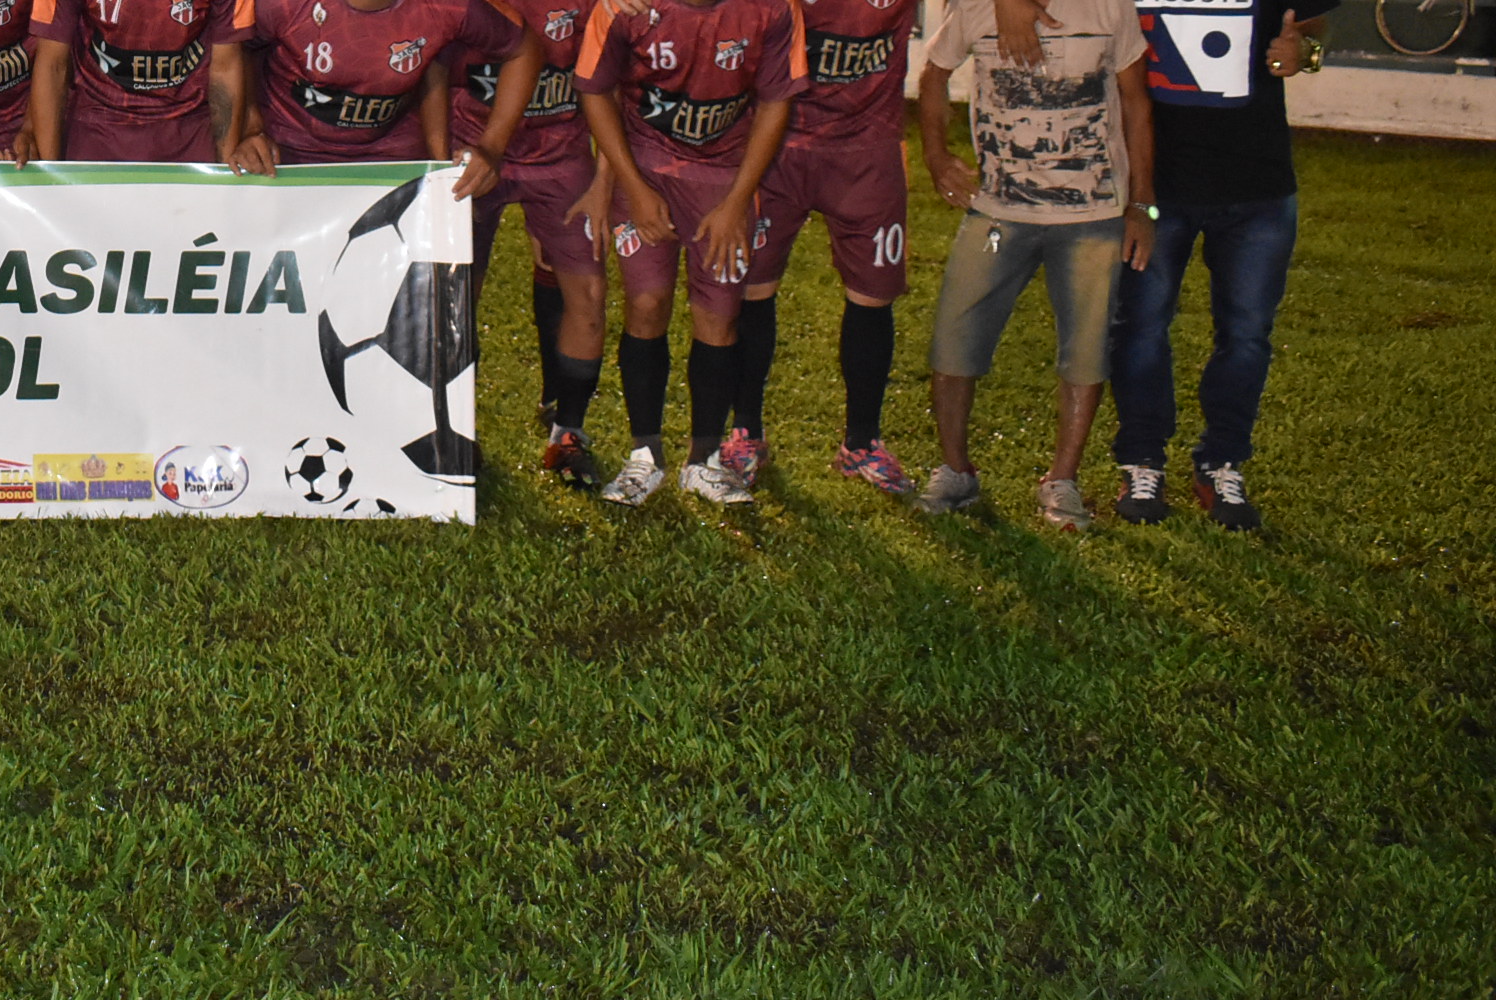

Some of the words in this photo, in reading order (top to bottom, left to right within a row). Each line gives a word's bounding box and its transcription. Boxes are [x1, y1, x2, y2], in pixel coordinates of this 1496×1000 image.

[303, 41, 334, 73] 18
[647, 41, 677, 71] 15
[872, 222, 903, 268] 10
